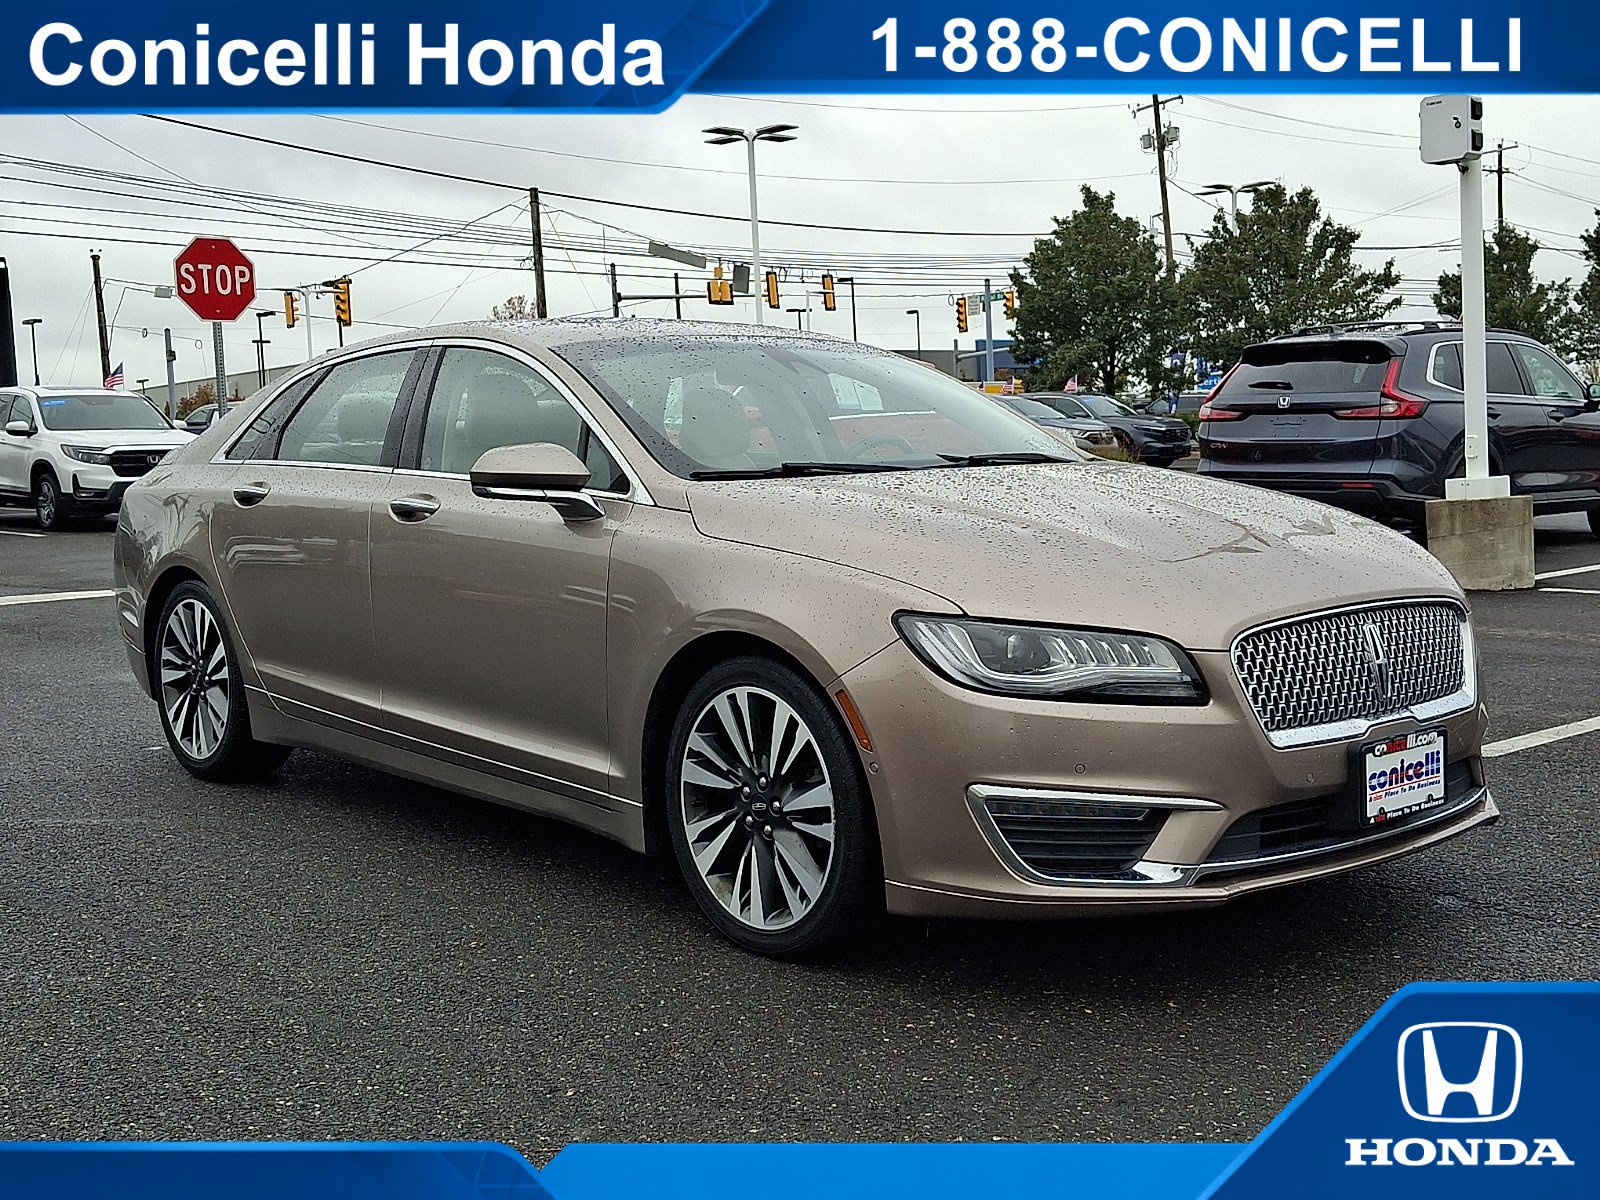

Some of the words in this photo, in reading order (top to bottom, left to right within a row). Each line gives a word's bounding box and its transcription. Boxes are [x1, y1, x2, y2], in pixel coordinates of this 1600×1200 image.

[180, 263, 250, 296] STOP
[1369, 750, 1440, 791] conicelli
[1421, 799, 1444, 809] Business
